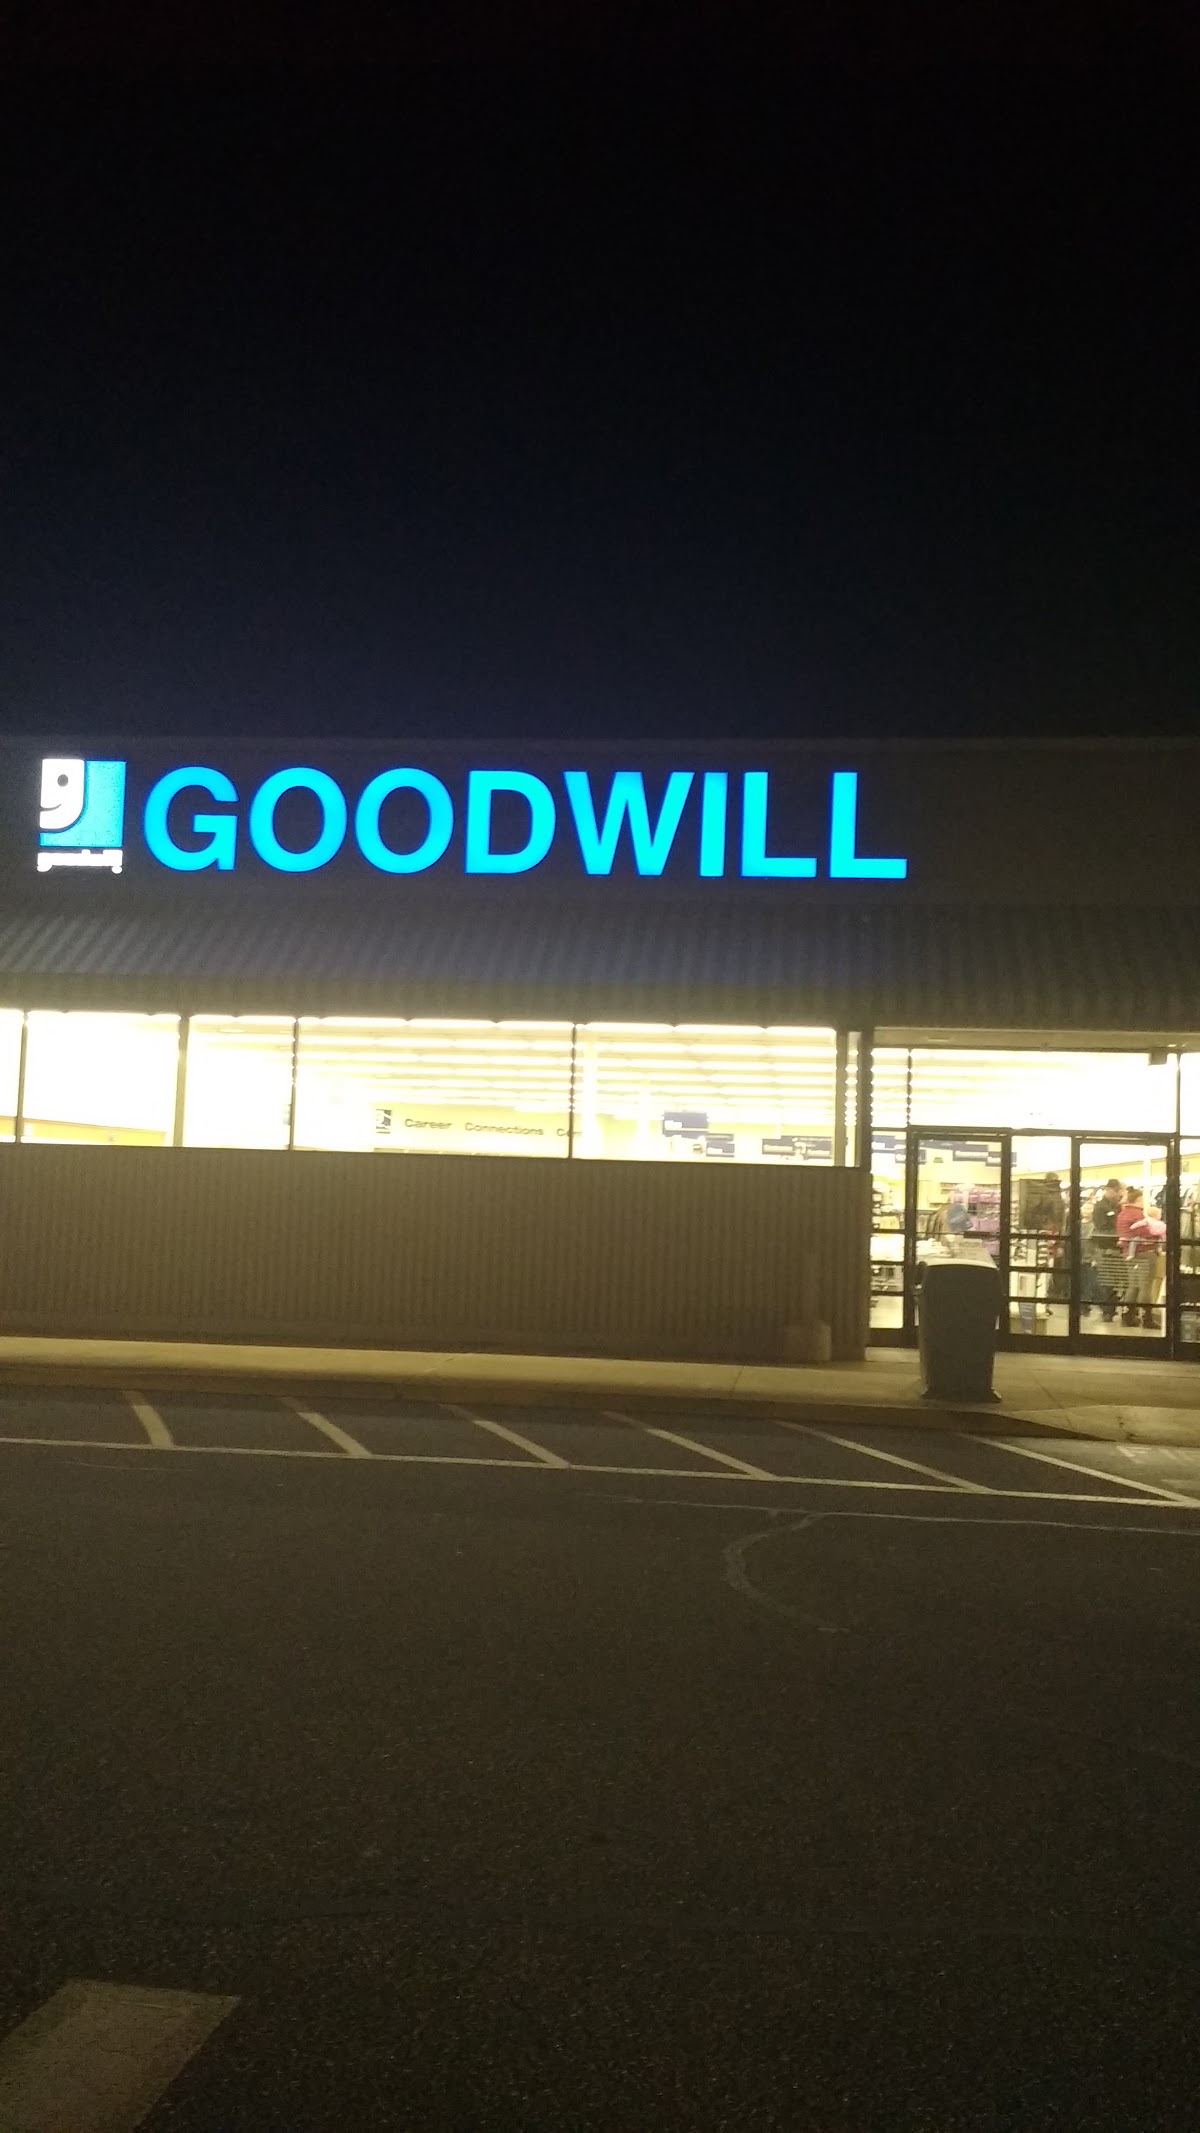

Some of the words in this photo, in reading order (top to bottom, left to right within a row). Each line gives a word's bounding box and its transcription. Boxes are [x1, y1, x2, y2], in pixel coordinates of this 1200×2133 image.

[142, 765, 908, 880] GOODWILL
[404, 1118, 453, 1130] Career
[464, 1121, 544, 1137] Connections
